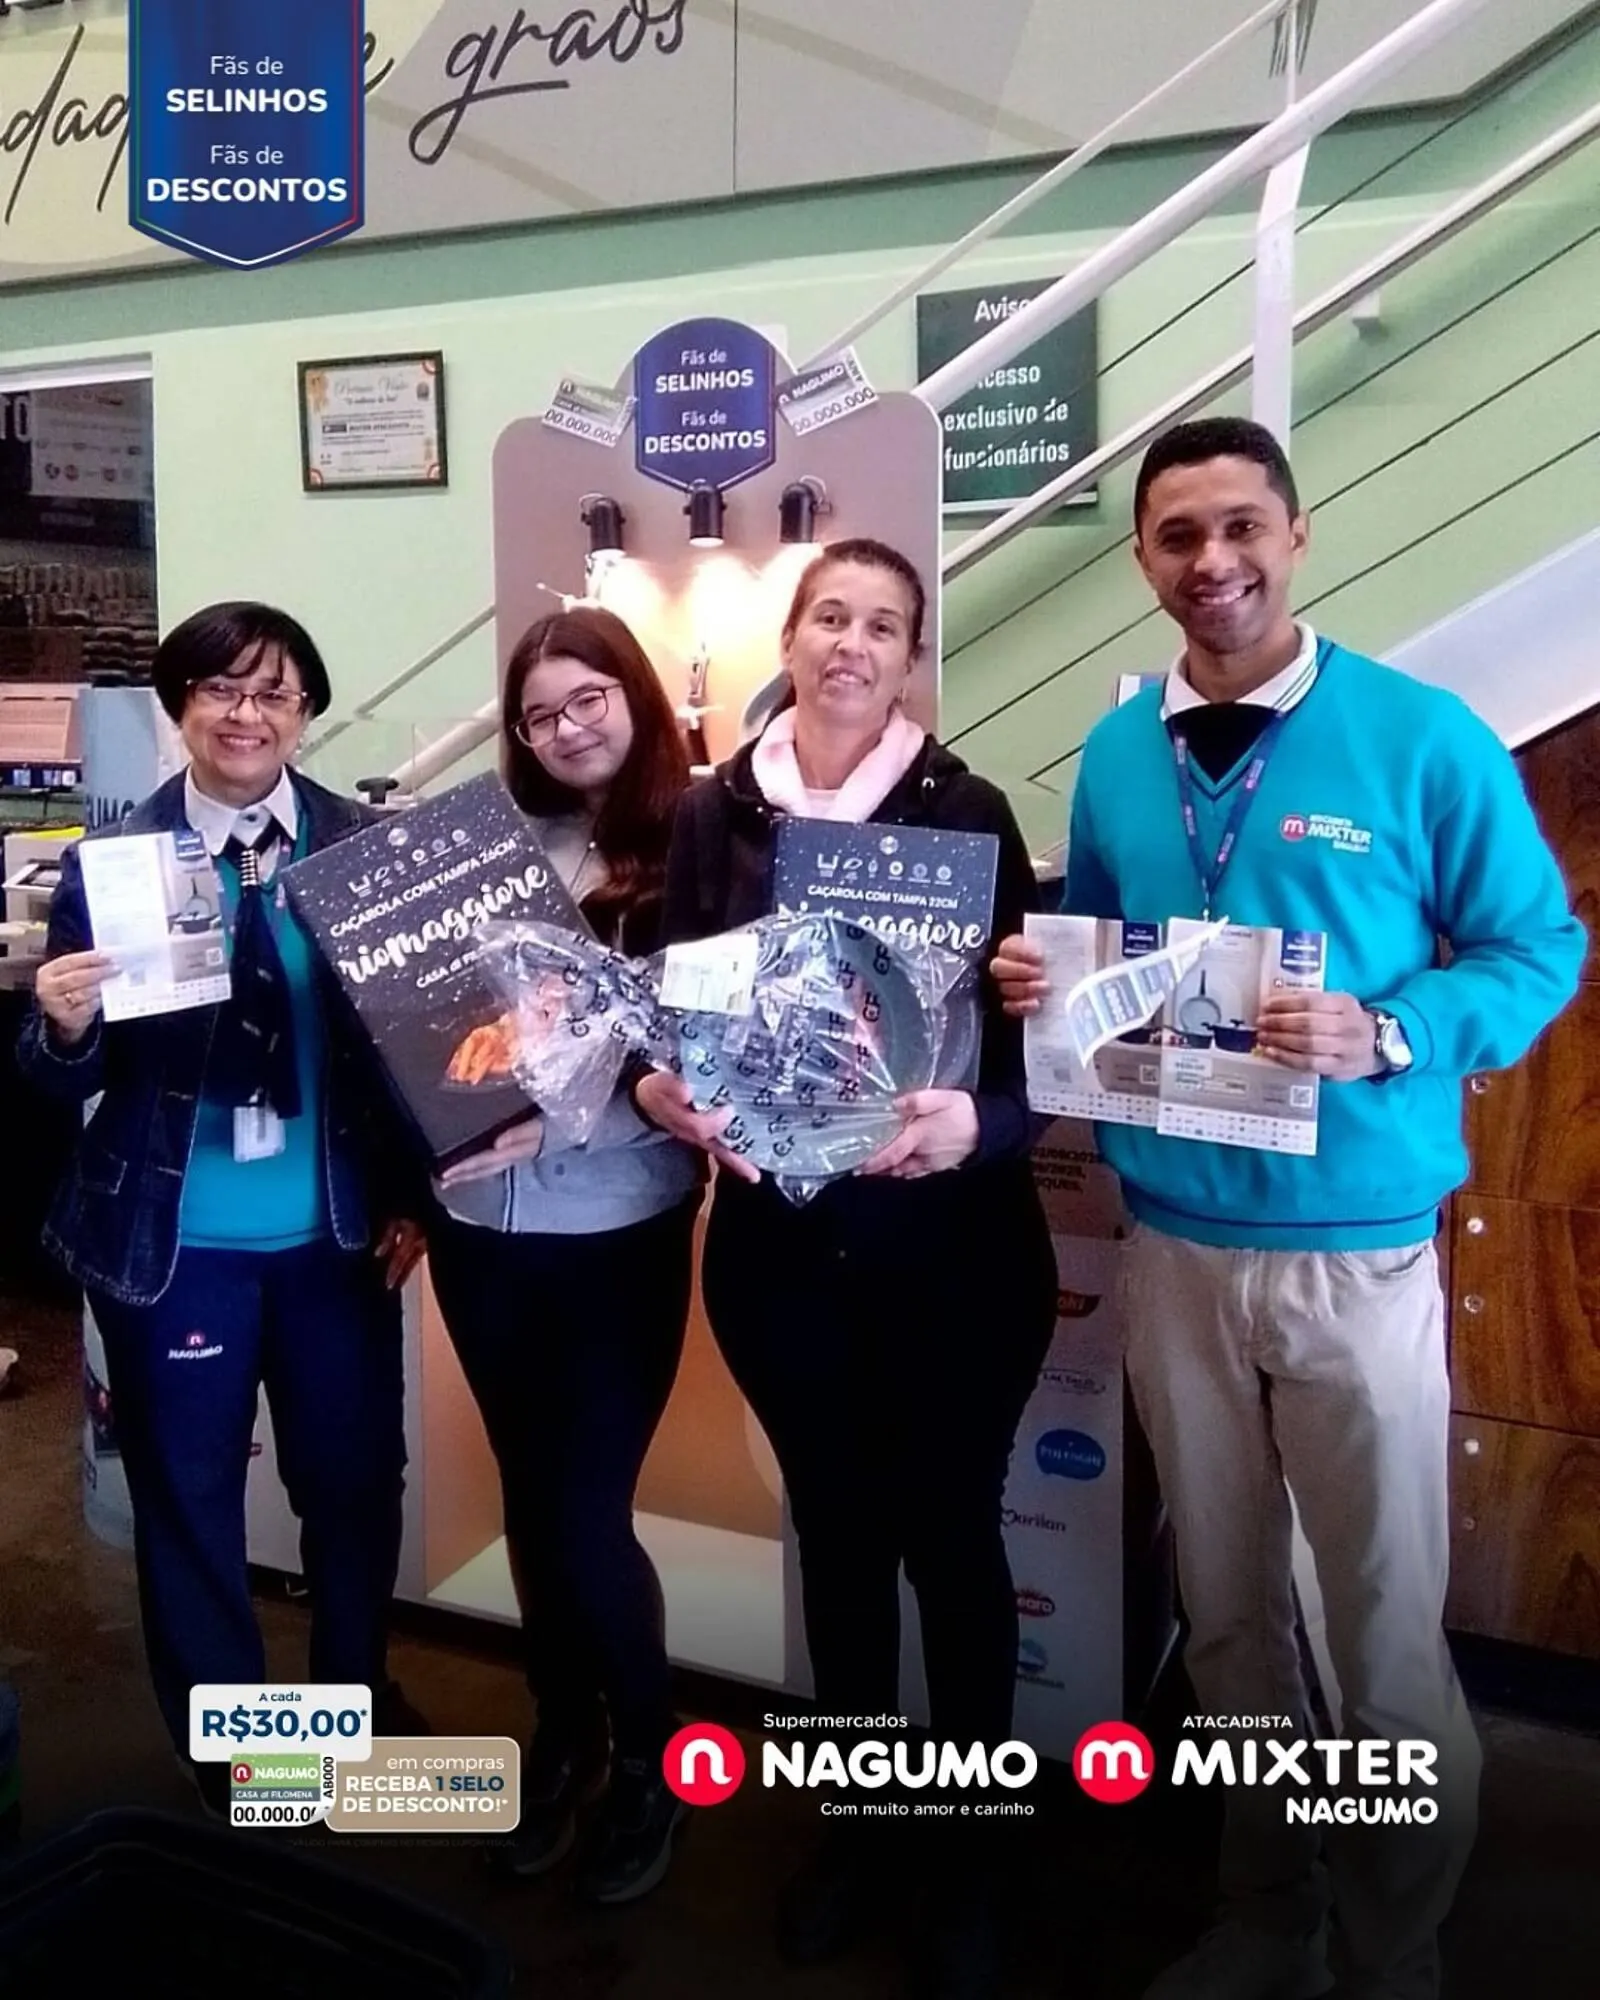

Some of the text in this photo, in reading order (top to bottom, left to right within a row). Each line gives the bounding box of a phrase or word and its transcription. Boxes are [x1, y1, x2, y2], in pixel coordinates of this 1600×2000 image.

[681, 349, 727, 365] Fãs de
[655, 369, 755, 394] SELINHOS
[681, 410, 727, 426] Fãs de
[944, 397, 1069, 431] exclusivo de
[644, 430, 767, 454] DESCONTOS
[945, 438, 1070, 471] funcionários
[1307, 823, 1372, 845] MIXTER
[330, 896, 403, 938] CAÇAROLA
[403, 880, 437, 902] COM
[434, 858, 480, 887] TAMPA
[808, 885, 959, 909] CAÇAROLA COM TAMPA 22CM
[337, 865, 548, 983] riomaggiore
[168, 1344, 224, 1360] NAGUMO
